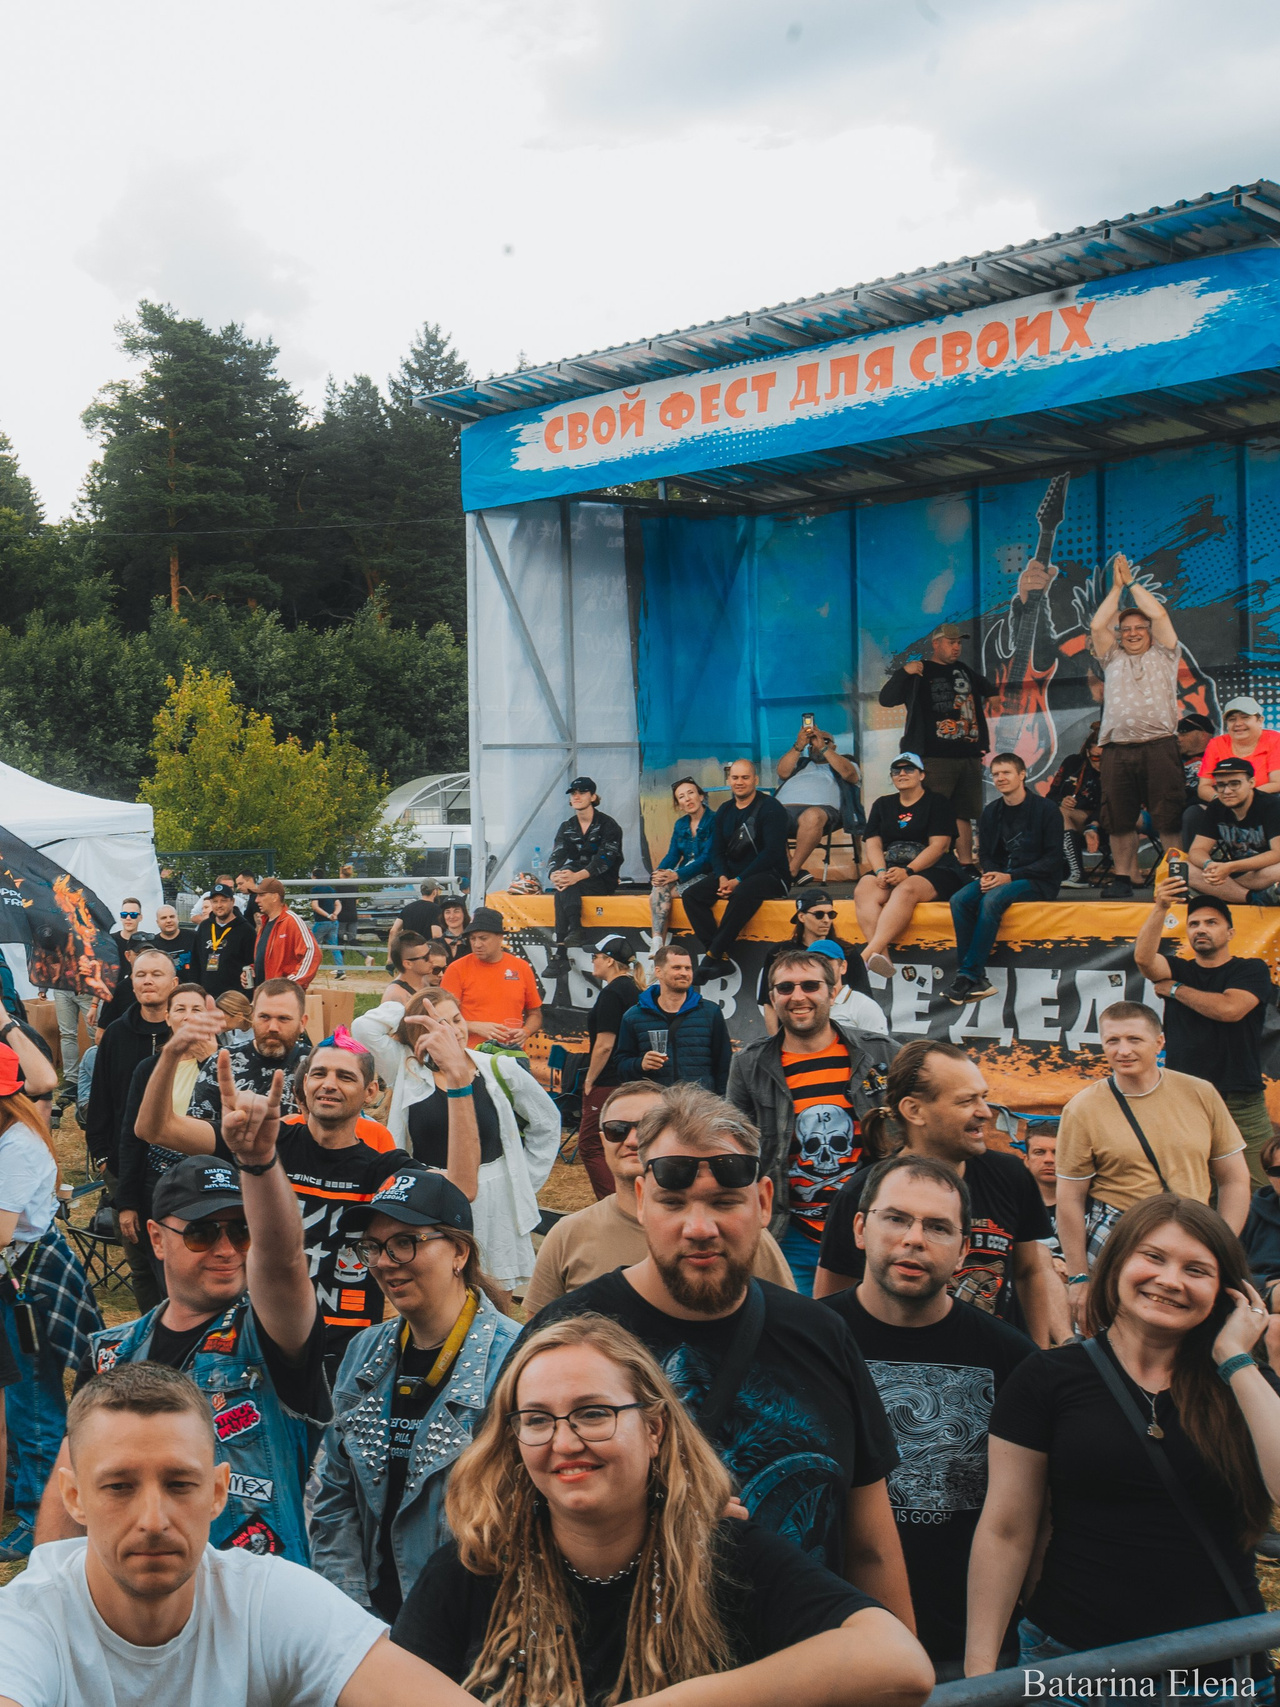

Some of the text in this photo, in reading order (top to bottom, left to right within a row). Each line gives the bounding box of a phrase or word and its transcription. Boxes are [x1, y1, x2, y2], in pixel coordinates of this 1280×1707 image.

[544, 301, 1097, 454] СВОЙ ФЕСТ ДЛЯ СВОИХ
[948, 963, 1166, 1051] ДЕД
[816, 1112, 831, 1123] 13
[896, 1509, 908, 1523] IS
